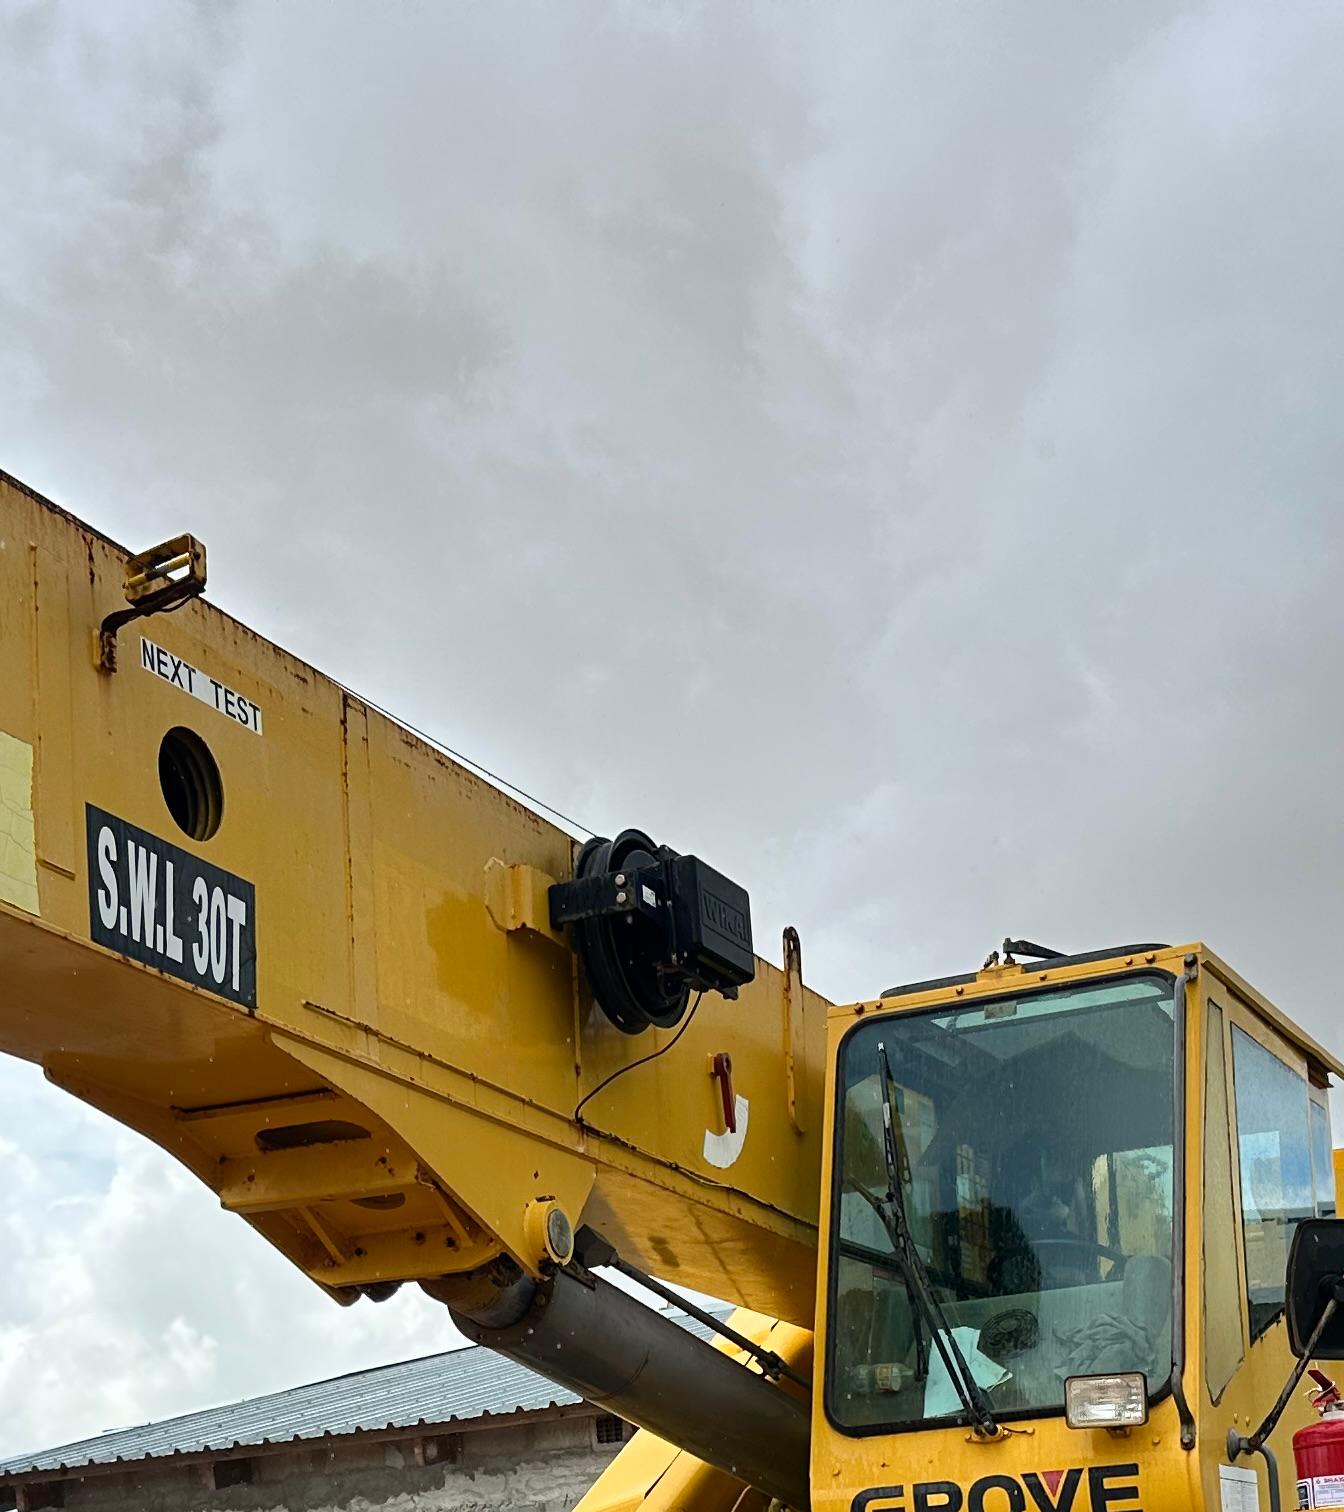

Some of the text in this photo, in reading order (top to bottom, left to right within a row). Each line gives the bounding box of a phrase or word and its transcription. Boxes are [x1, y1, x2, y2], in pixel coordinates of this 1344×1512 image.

[142, 638, 261, 731] NEXT TEST
[97, 826, 246, 992] S.W.L 30T
